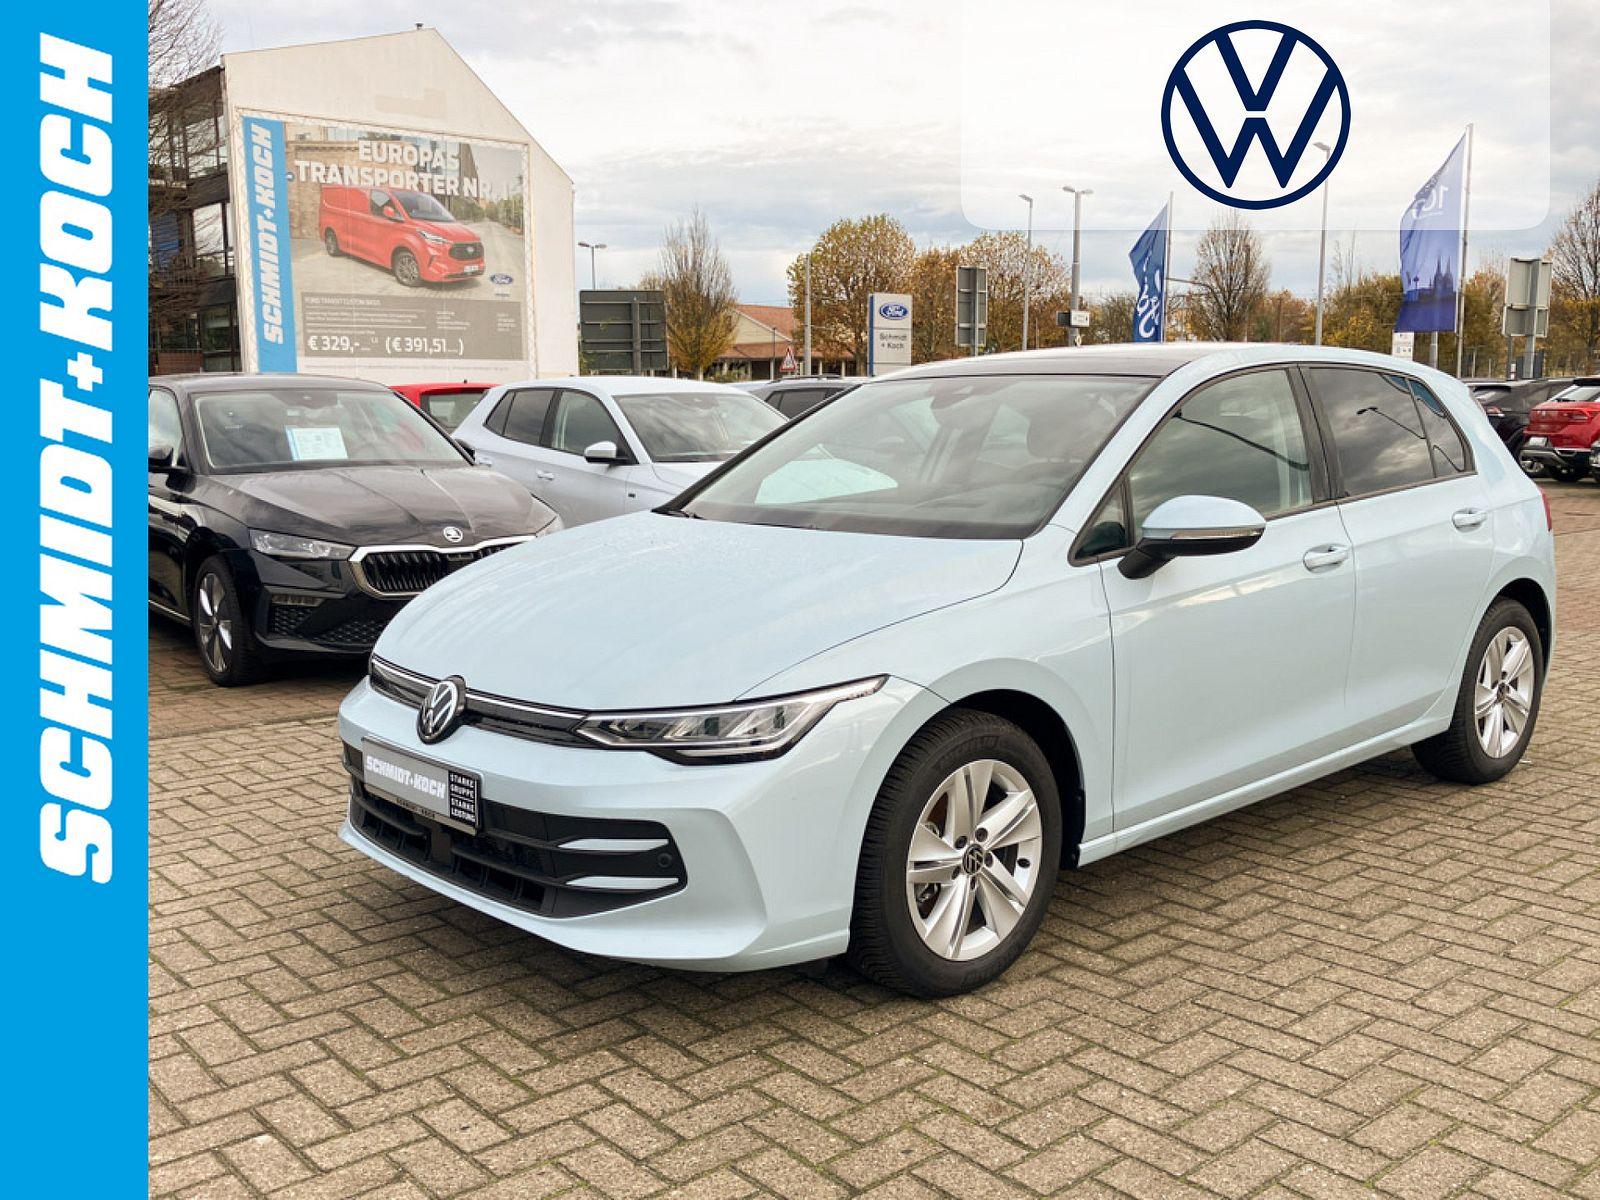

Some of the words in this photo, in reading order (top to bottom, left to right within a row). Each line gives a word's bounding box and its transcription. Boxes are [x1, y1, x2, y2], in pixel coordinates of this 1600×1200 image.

[358, 139, 460, 172] EUROPAS
[294, 159, 459, 197] TRANSPORTER
[251, 122, 283, 344] SCHMIDT+KOCH
